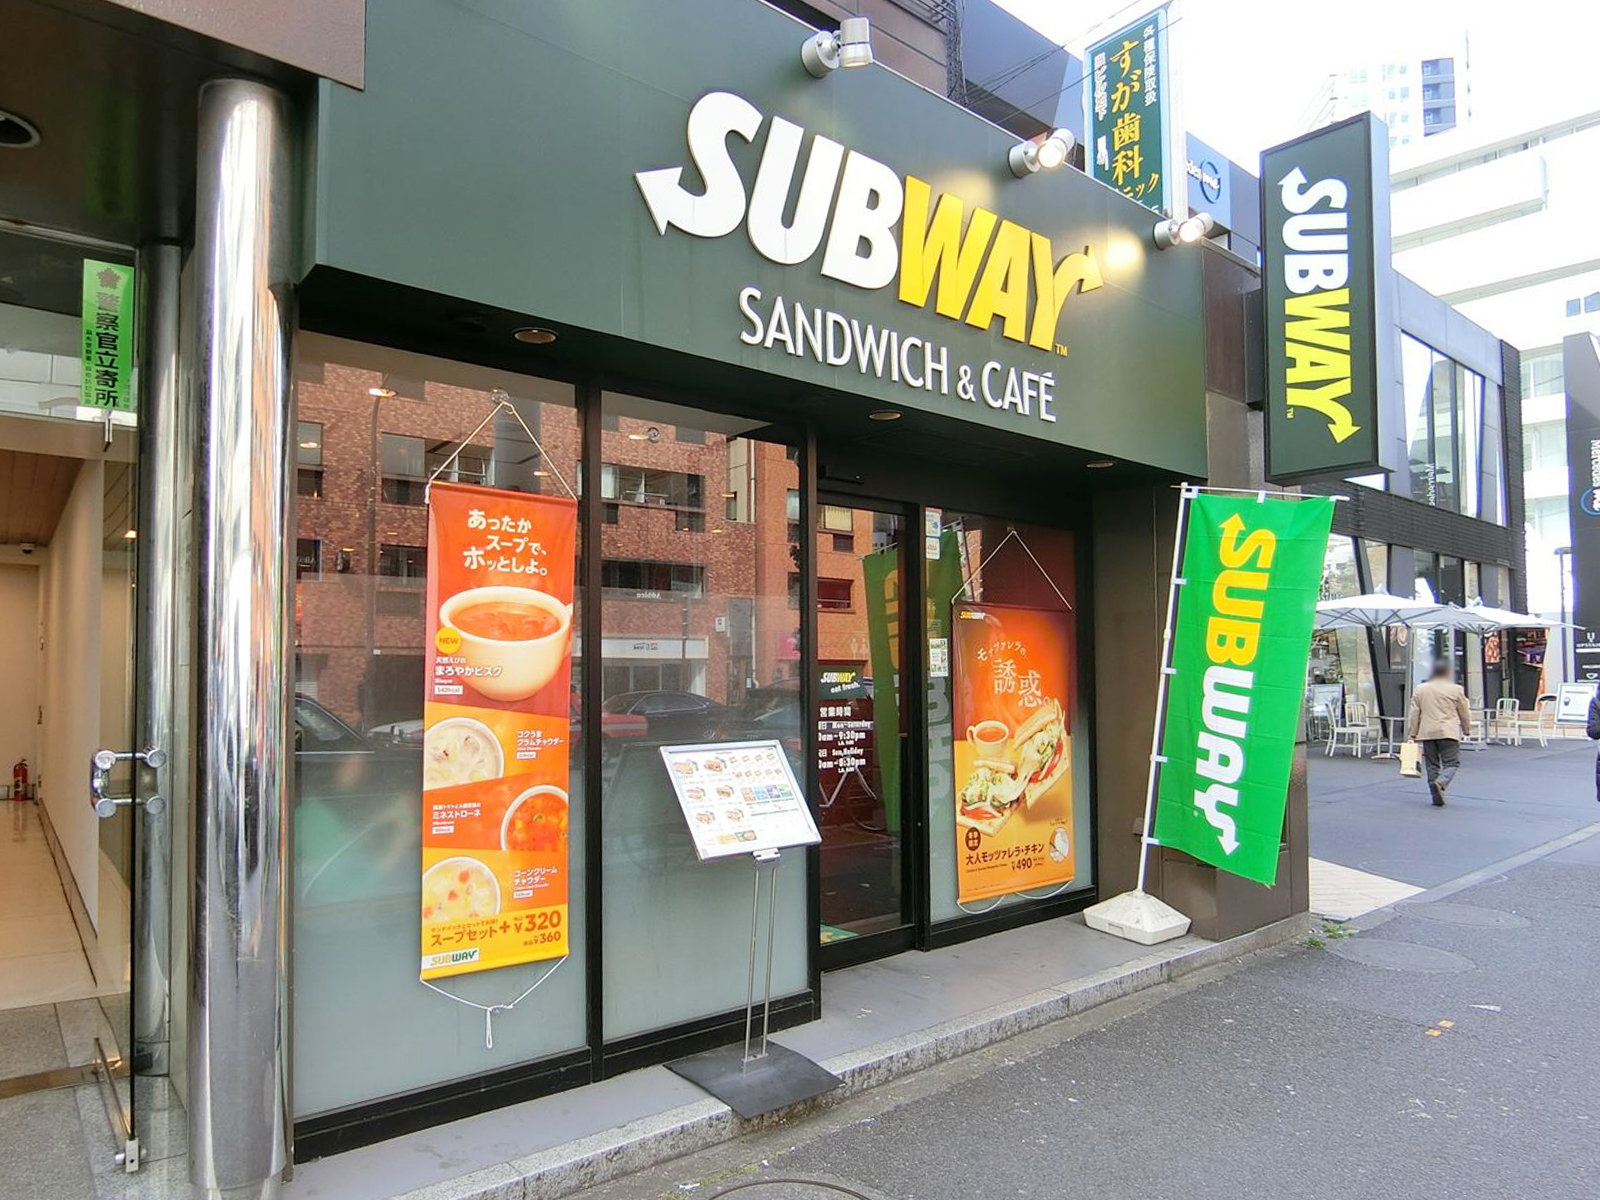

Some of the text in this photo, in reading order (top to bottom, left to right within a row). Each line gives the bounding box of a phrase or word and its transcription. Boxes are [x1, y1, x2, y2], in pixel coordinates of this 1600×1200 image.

[1110, 39, 1143, 186] すが歯科
[635, 91, 1103, 352] SUBWAY
[1278, 166, 1362, 444] SUBWAY
[739, 286, 1056, 423] SANDWICH & CAFÉ
[467, 509, 532, 534] あったか
[439, 636, 459, 646] NEW
[434, 665, 503, 678] まろやかビスク
[820, 672, 857, 684] SUBWAY
[1194, 512, 1276, 856] SUBWAY
[433, 810, 481, 820] ミネストローネ
[514, 866, 558, 878] コーンクリーム
[514, 876, 546, 886] チャウダー
[430, 925, 498, 947] スープセット
[514, 910, 562, 934] ¥320
[430, 950, 478, 967] SUBWAY
